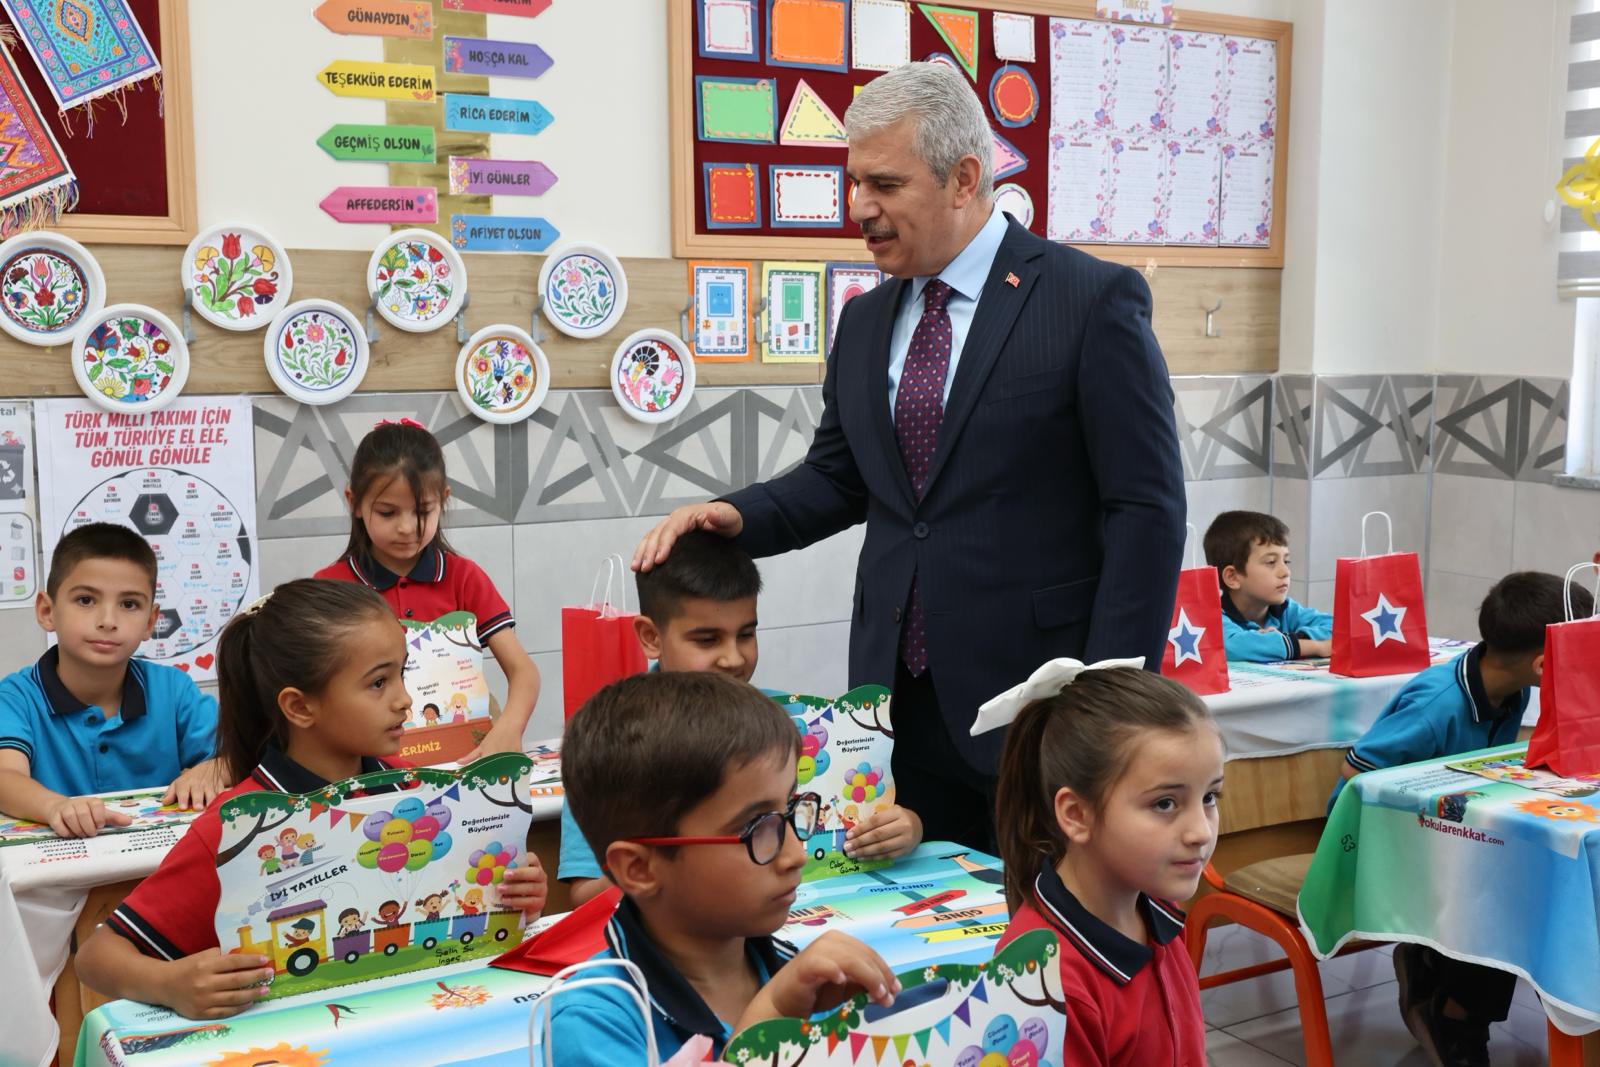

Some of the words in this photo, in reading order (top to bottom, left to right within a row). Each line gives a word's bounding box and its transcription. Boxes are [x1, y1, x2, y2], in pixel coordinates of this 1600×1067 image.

[347, 9, 410, 26] GÜNAYDIN
[468, 50, 505, 68] HOŞÇA
[507, 52, 529, 66] KAL
[325, 71, 385, 89] TEŞEKKÜR
[388, 74, 433, 91] EDERİM
[459, 106, 486, 120] RİCA
[489, 108, 530, 124] EDERİM
[334, 135, 381, 153] GEÇMİŞ
[383, 136, 421, 150] OLSUN
[487, 170, 530, 186] GÜNLER
[346, 197, 414, 211] AFFEDERSİN
[470, 224, 505, 239] AFİYET
[507, 226, 542, 240] OLSUN
[65, 410, 103, 429] TÜRK
[150, 410, 197, 426] TAKIMI
[201, 406, 232, 427] İÇİN
[75, 429, 109, 448] TÜM
[114, 427, 176, 446] TÜRKİYE
[180, 429, 196, 445] EL
[199, 428, 229, 446] ELE,
[91, 447, 144, 468] GÖNÜL
[149, 445, 212, 466] GÖNÜLE
[461, 813, 510, 827] Değerlerimizle
[467, 822, 504, 835] Büyüyoruz
[290, 865, 348, 893] TATİLLER
[932, 909, 984, 922] GÜNEY
